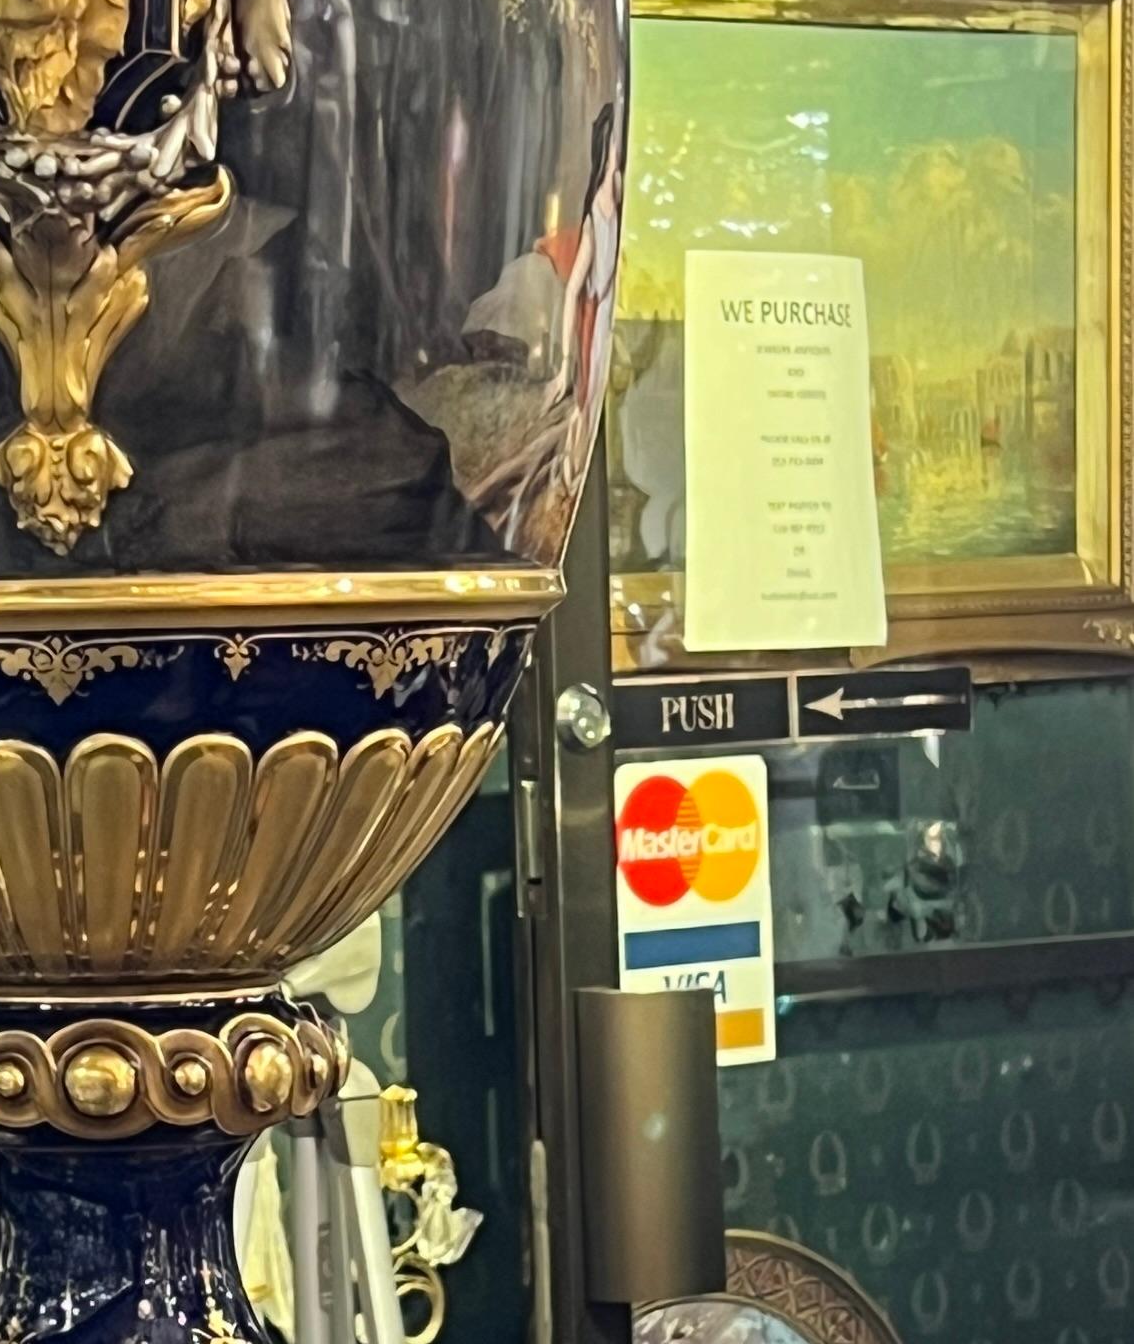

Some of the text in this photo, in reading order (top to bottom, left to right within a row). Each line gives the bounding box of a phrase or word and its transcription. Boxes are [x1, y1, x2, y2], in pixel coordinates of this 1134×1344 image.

[721, 299, 852, 327] WE PURCHASE
[661, 693, 734, 732] PUSH
[620, 822, 757, 863] MasterCard
